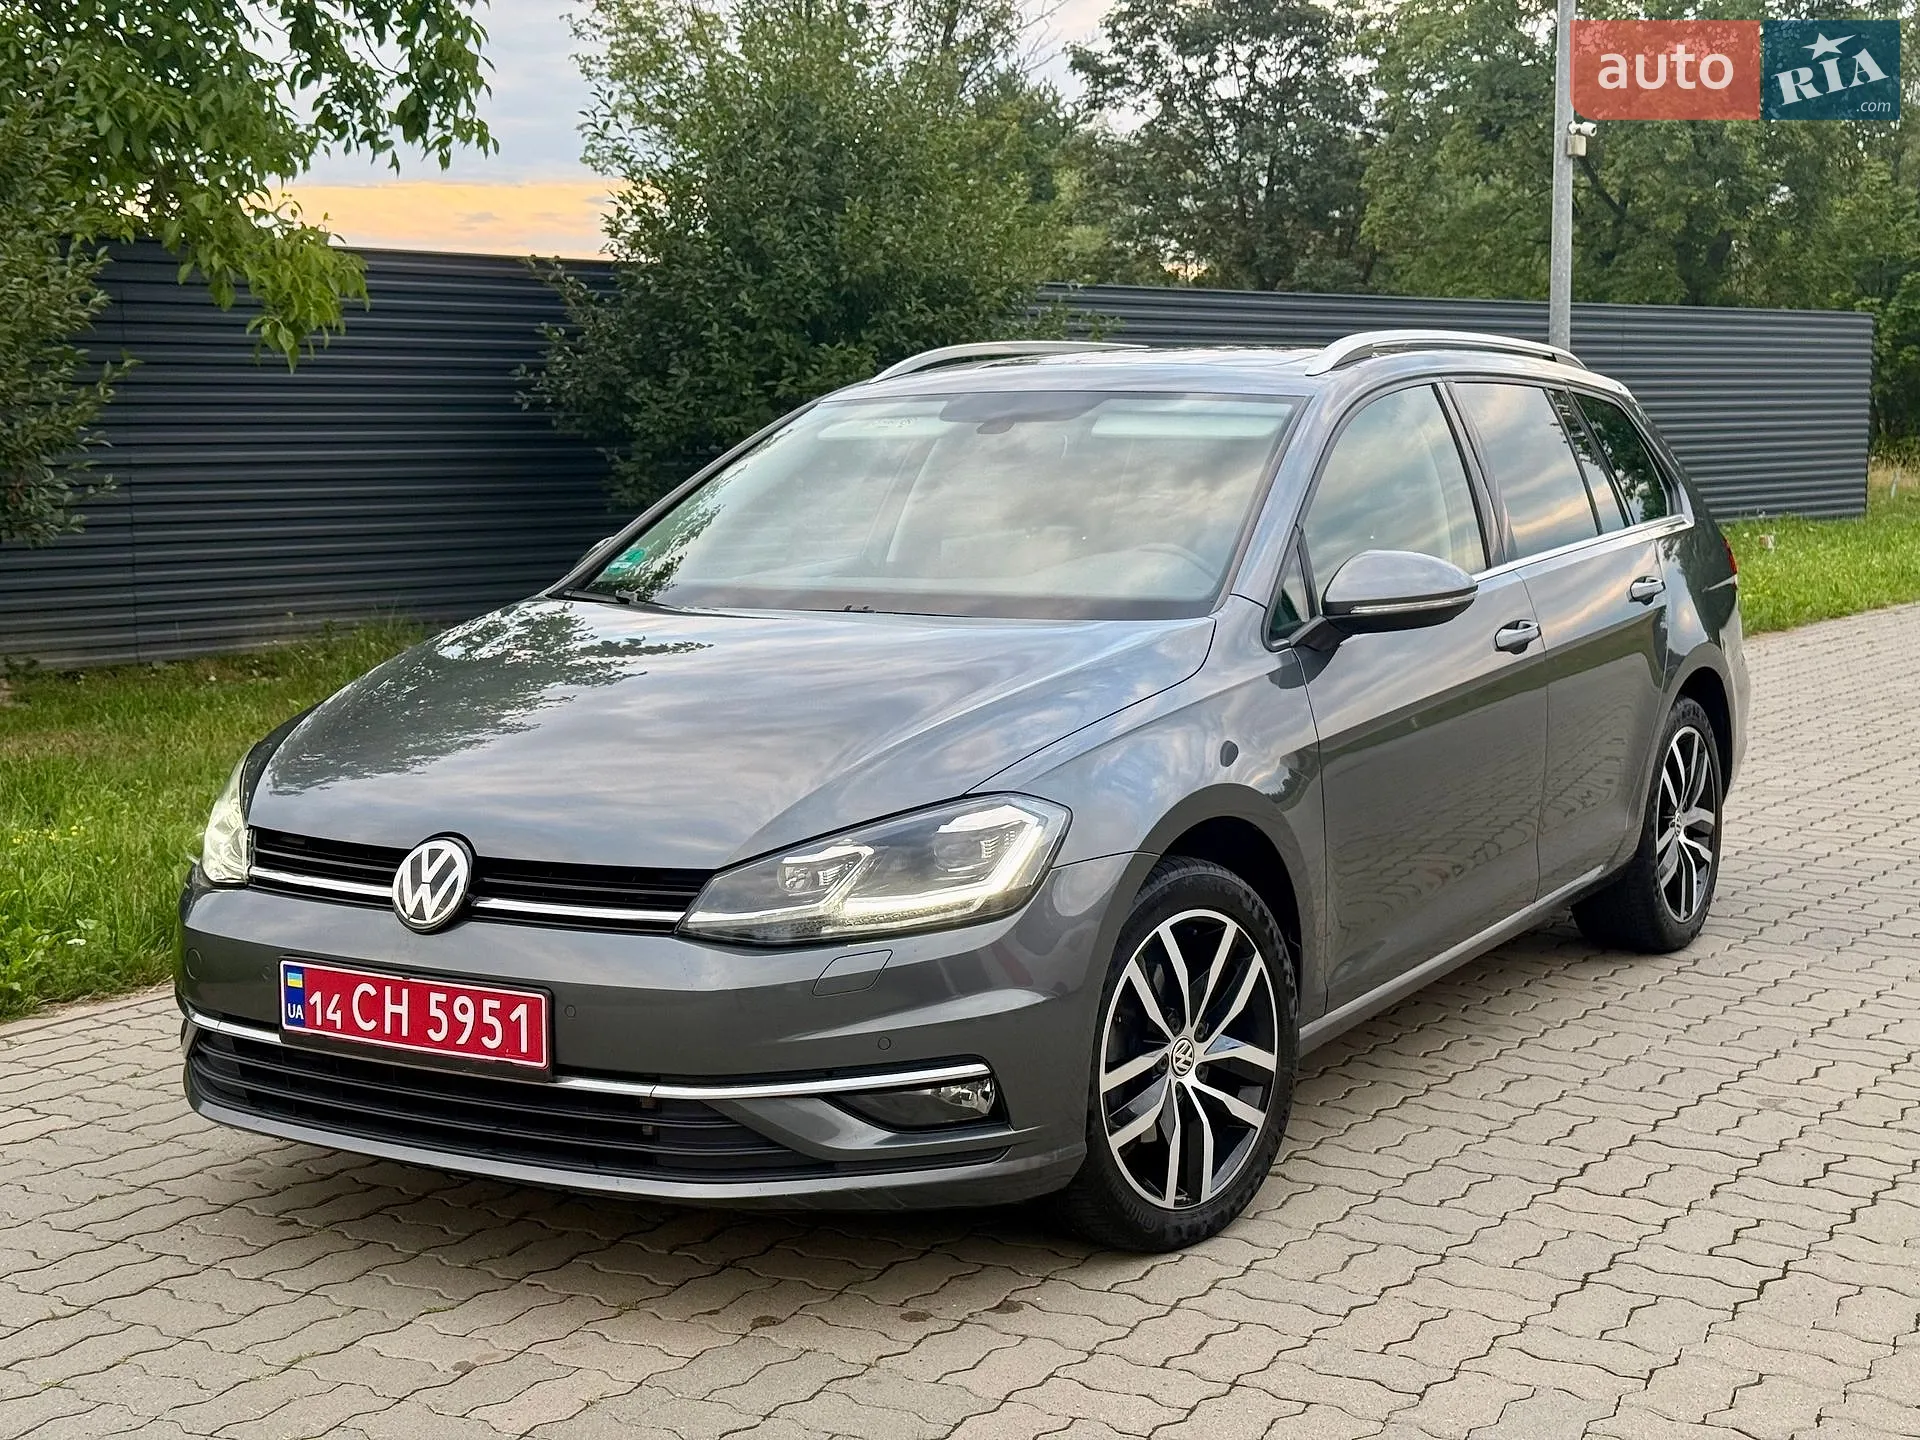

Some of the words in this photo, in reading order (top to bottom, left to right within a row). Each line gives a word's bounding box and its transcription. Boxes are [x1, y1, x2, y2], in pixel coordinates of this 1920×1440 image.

[287, 1003, 304, 1020] UA
[308, 991, 342, 1029] 14
[352, 983, 408, 1037] CH
[427, 991, 528, 1053] 5951
